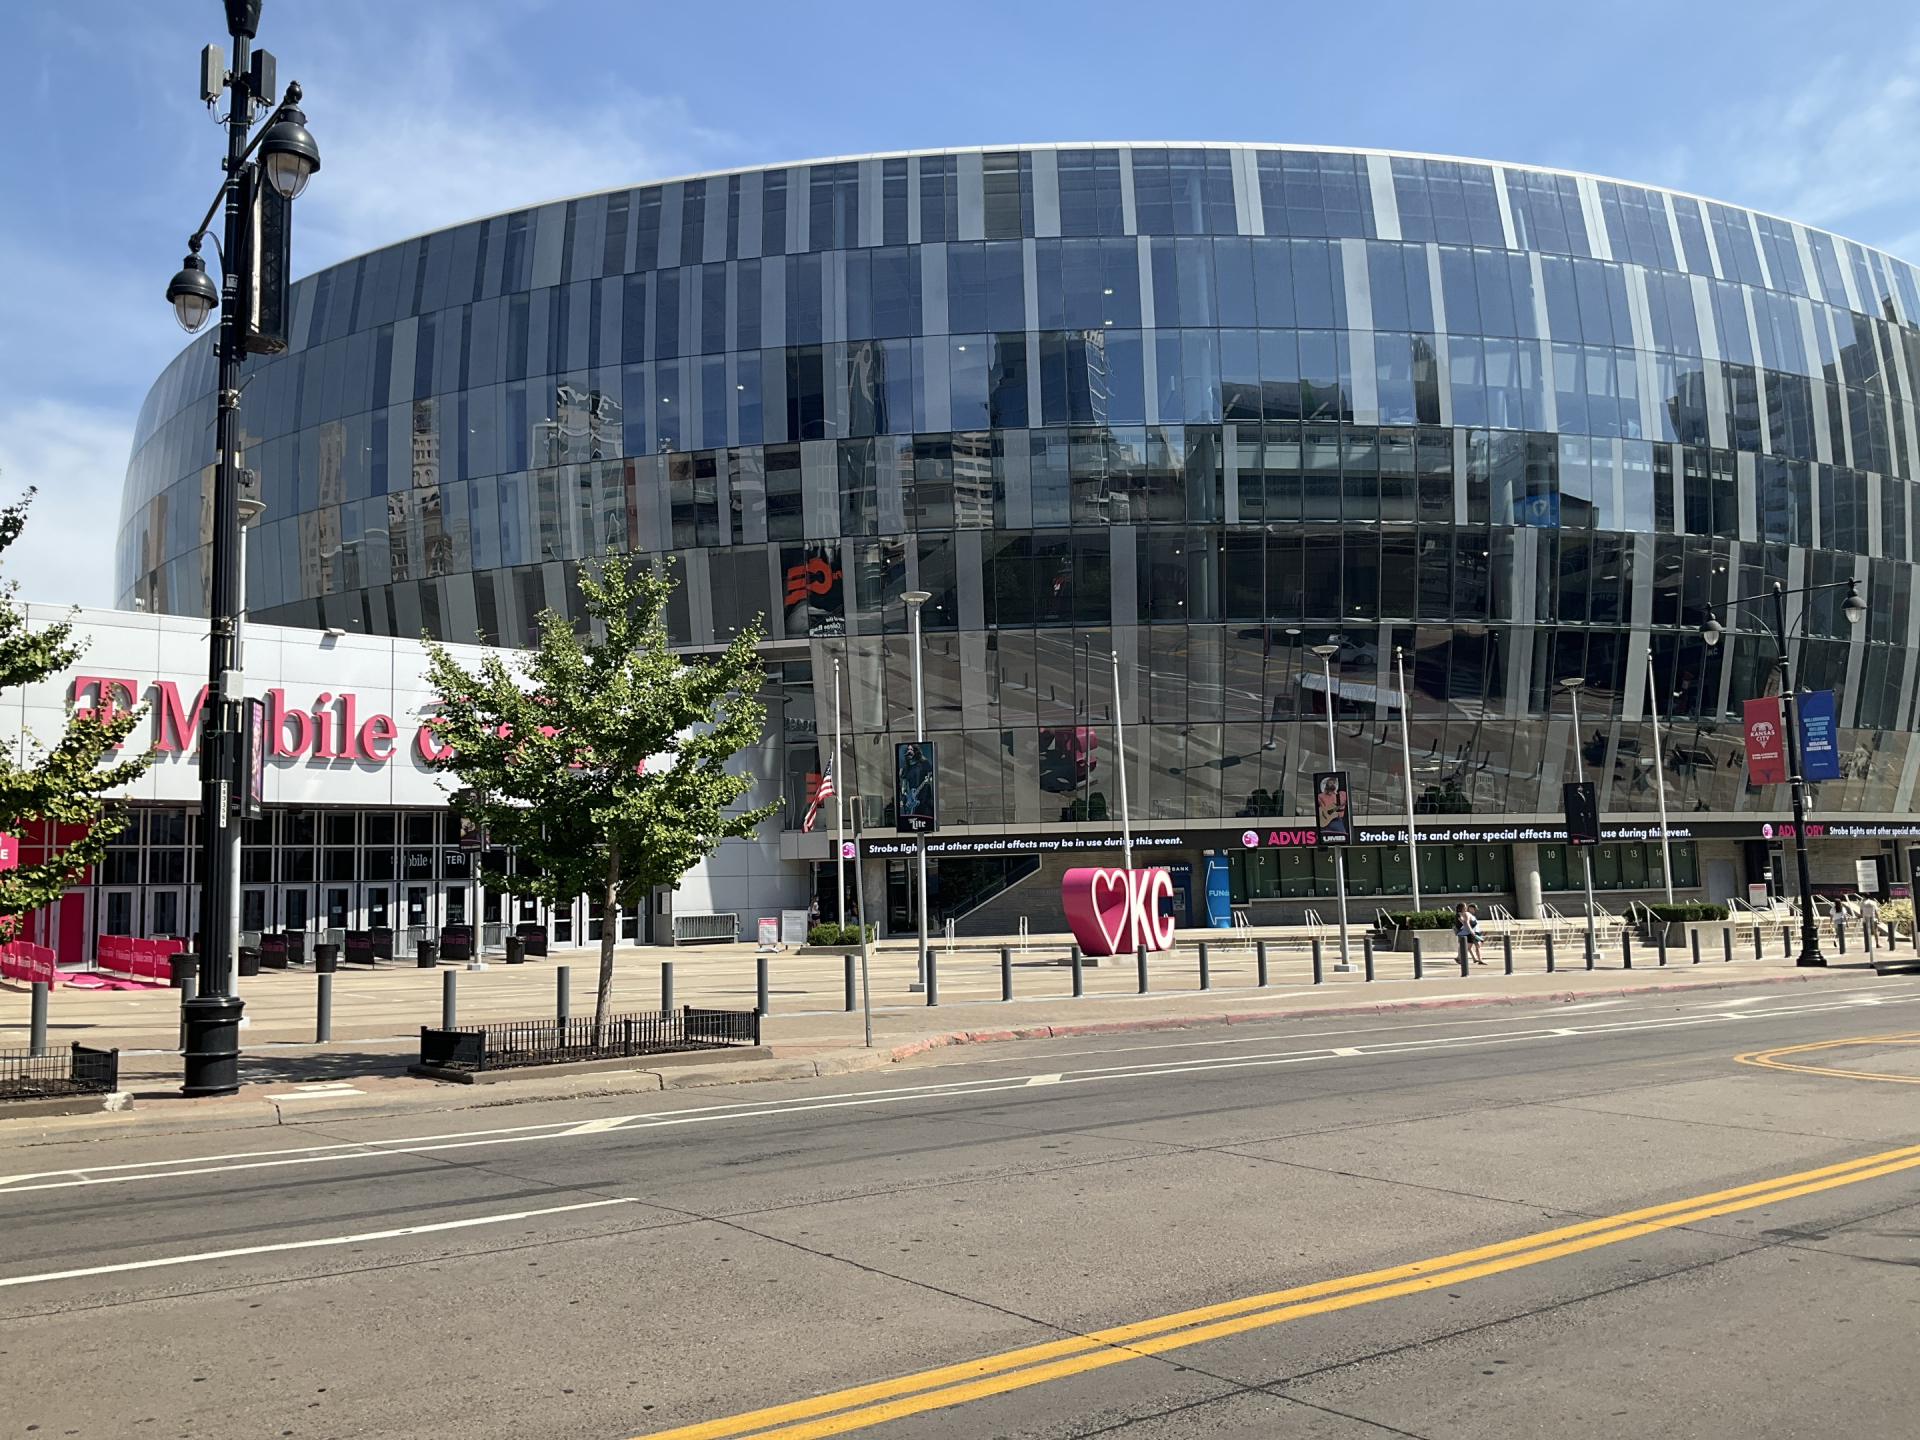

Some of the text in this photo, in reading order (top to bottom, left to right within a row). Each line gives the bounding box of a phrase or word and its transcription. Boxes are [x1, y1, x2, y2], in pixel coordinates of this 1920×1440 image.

[153, 680, 398, 761] Mbile
[912, 819, 926, 830] Lite
[1778, 824, 1824, 836] ADVORY
[1829, 826, 1848, 835] Strobe
[1849, 825, 1865, 837] lights
[1866, 826, 1877, 835] and
[1877, 826, 1891, 835] other
[1892, 826, 1909, 836] special
[1268, 831, 1317, 846] ADVIS
[1360, 831, 1395, 842] Strobe
[1429, 830, 1450, 841] and
[1452, 830, 1480, 841] other
[1482, 829, 1517, 842] special
[1519, 828, 1551, 839] effects
[1553, 831, 1567, 839] ma
[1601, 830, 1616, 838] use
[1618, 828, 1647, 839] during
[1666, 828, 1691, 837] event.
[869, 836, 1183, 854] Strobe ligh and other special effects may be in use durig this event.
[1394, 853, 1400, 862] 6
[1427, 853, 1432, 861] 7
[1458, 852, 1464, 861] 8
[1489, 852, 1495, 860] 9
[1547, 850, 1555, 859] 10
[1603, 850, 1611, 858] 12
[1630, 849, 1637, 858] 13
[1655, 849, 1662, 857] 14
[1680, 849, 1687, 857] 15
[1230, 857, 1235, 866] 1
[1259, 856, 1265, 865] 2
[1294, 855, 1299, 864] 3
[1327, 855, 1333, 863] 4
[1362, 854, 1367, 863] 5
[1128, 869, 1175, 952] KC
